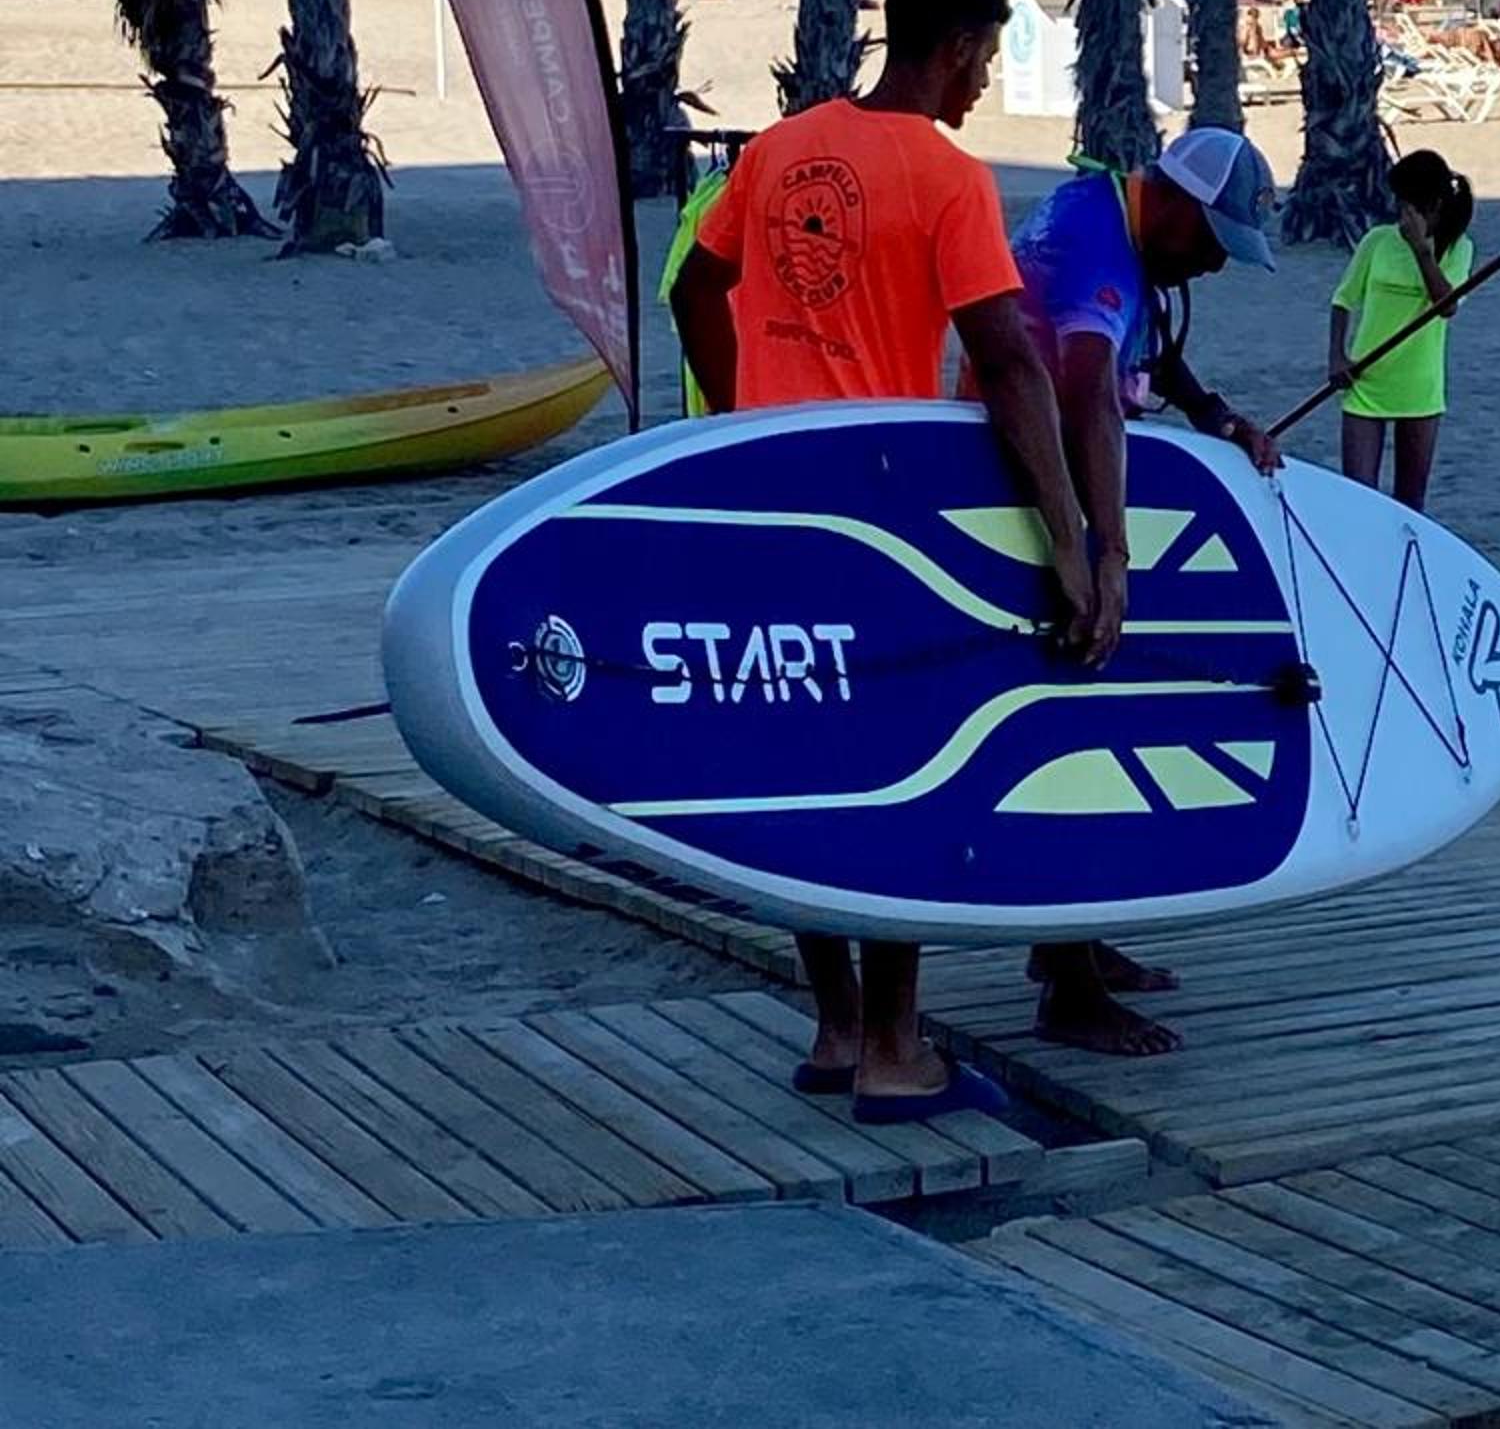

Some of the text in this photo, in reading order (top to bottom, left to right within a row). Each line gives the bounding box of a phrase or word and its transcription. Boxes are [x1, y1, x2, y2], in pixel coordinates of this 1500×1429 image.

[782, 163, 859, 208] CAMPELLO
[641, 621, 856, 704] START
[1451, 577, 1481, 667] KOHALA
